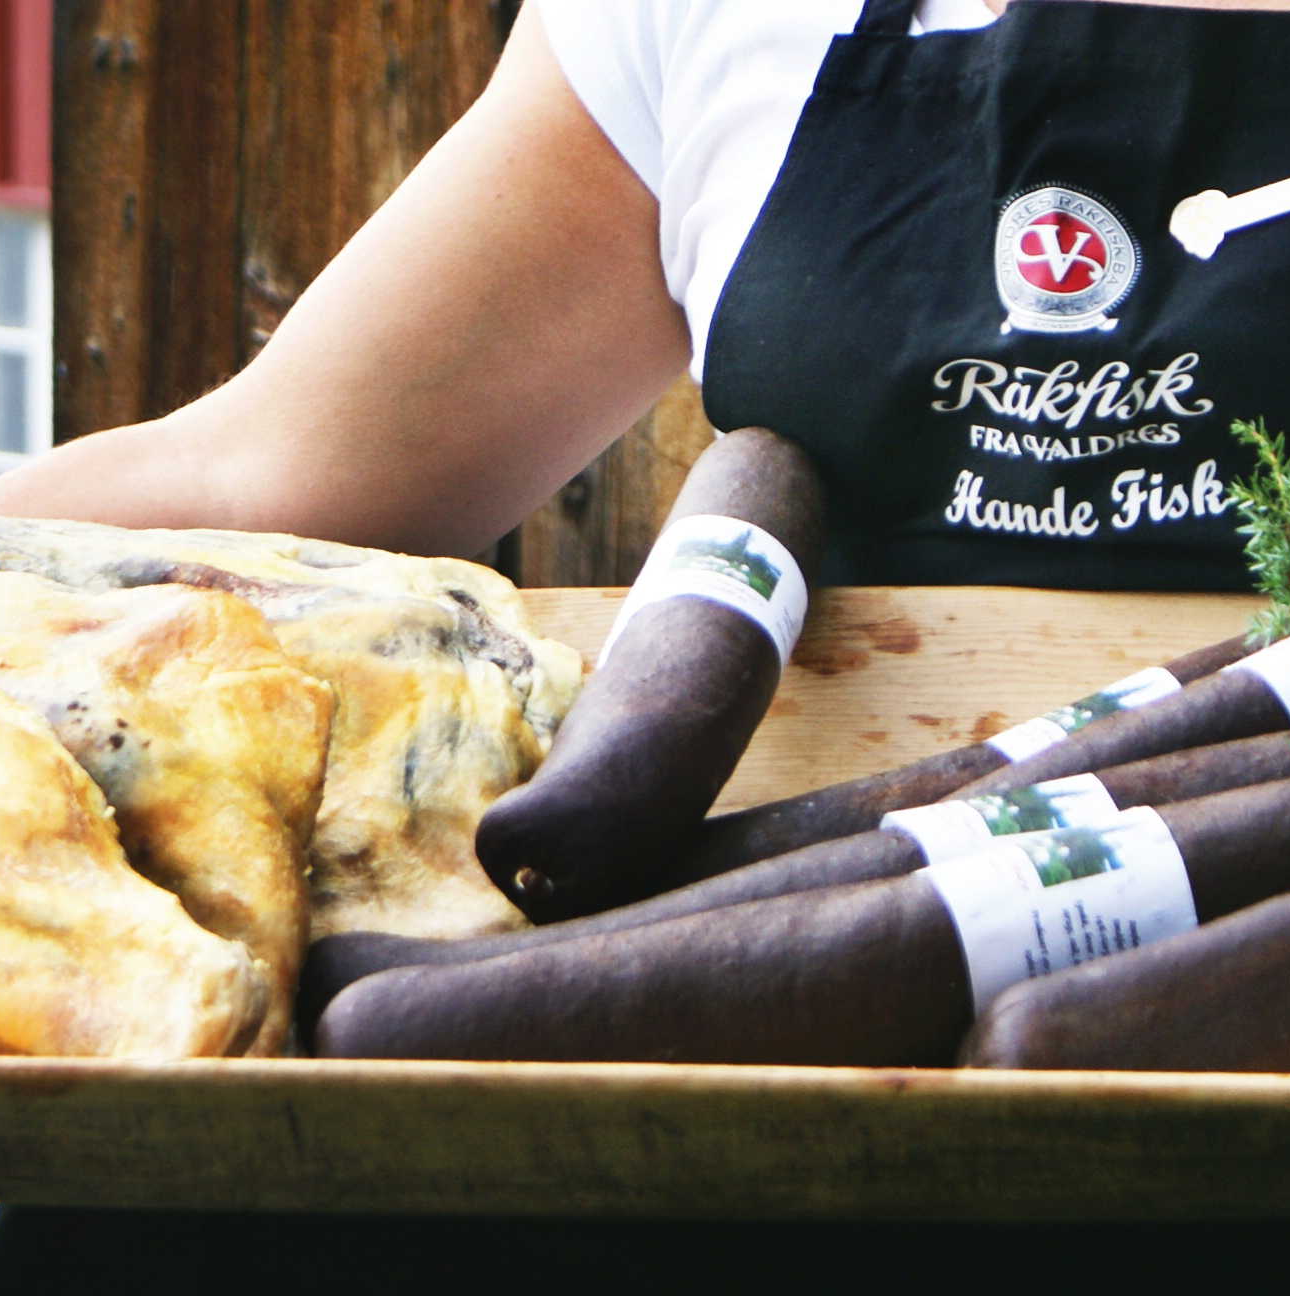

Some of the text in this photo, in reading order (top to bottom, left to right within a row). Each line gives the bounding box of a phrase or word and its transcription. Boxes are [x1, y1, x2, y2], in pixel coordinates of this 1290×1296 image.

[1059, 195, 1126, 257] RAKFISK
[970, 422, 1181, 462] FRA VALDRES
[945, 458, 1230, 537] Hande Fisk
